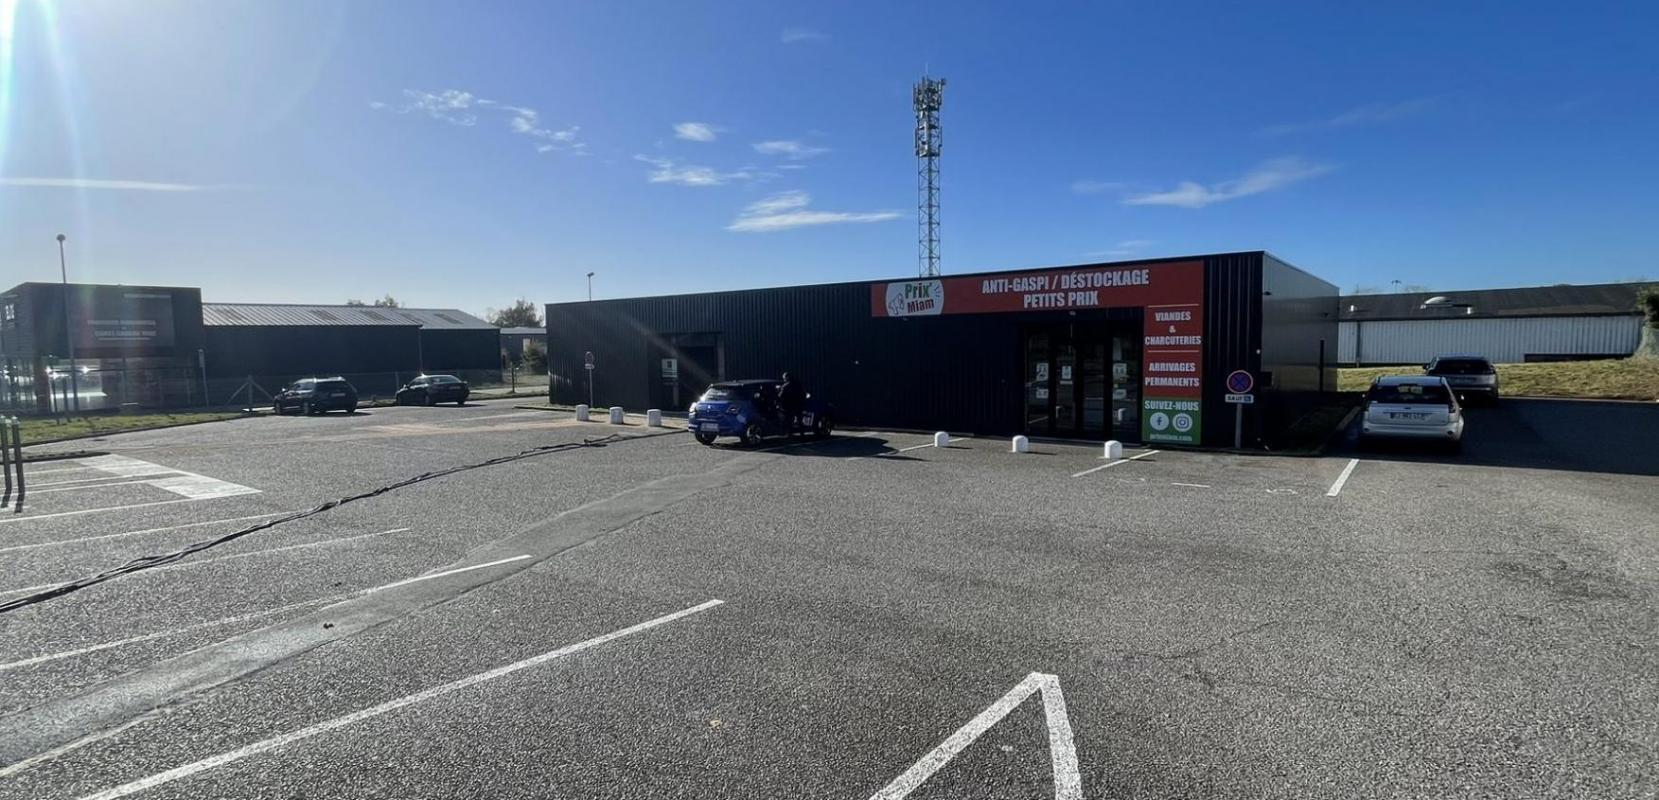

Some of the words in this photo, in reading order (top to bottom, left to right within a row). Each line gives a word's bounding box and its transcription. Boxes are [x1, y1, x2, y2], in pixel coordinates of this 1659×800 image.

[982, 276, 1049, 293] ANTI-GASPI
[1052, 275, 1058, 290] /
[1061, 269, 1149, 289] DÉSTOCKAGE
[1024, 292, 1065, 308] PETITS
[1068, 291, 1098, 306] PRIX
[907, 299, 934, 313] Miam
[1155, 311, 1191, 321] VIANDES
[1169, 325, 1176, 333] &
[1145, 336, 1201, 345] CHARCUTERIES
[1149, 362, 1195, 371] ARRIVAGES
[1145, 377, 1199, 387] PERMANENTS
[1145, 401, 1199, 410] SUIVEZ-NOUS
